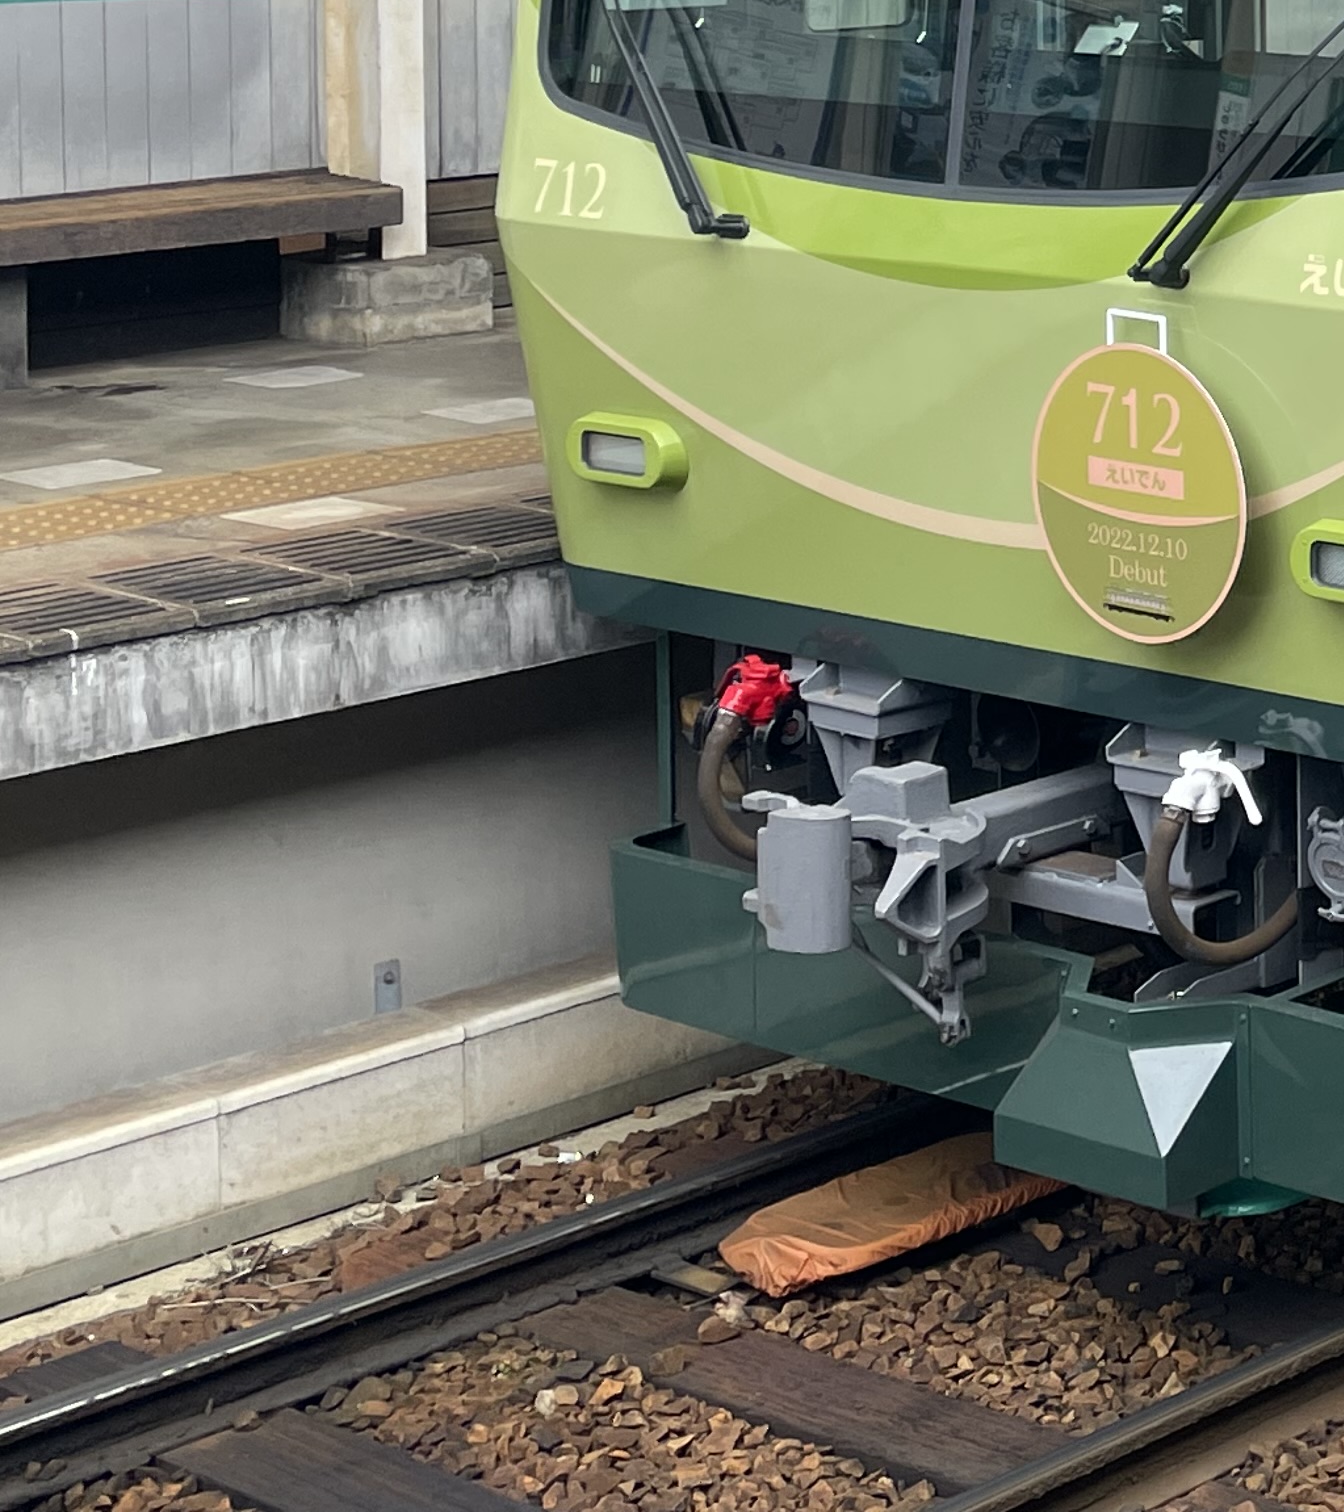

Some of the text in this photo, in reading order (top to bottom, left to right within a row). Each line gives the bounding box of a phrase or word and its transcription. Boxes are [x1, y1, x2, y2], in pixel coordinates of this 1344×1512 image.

[533, 157, 607, 220] 712
[1086, 381, 1183, 457] 712
[1105, 462, 1166, 492] えいでん
[1087, 522, 1188, 561] 2022.12.10
[1108, 554, 1169, 588] Debut
